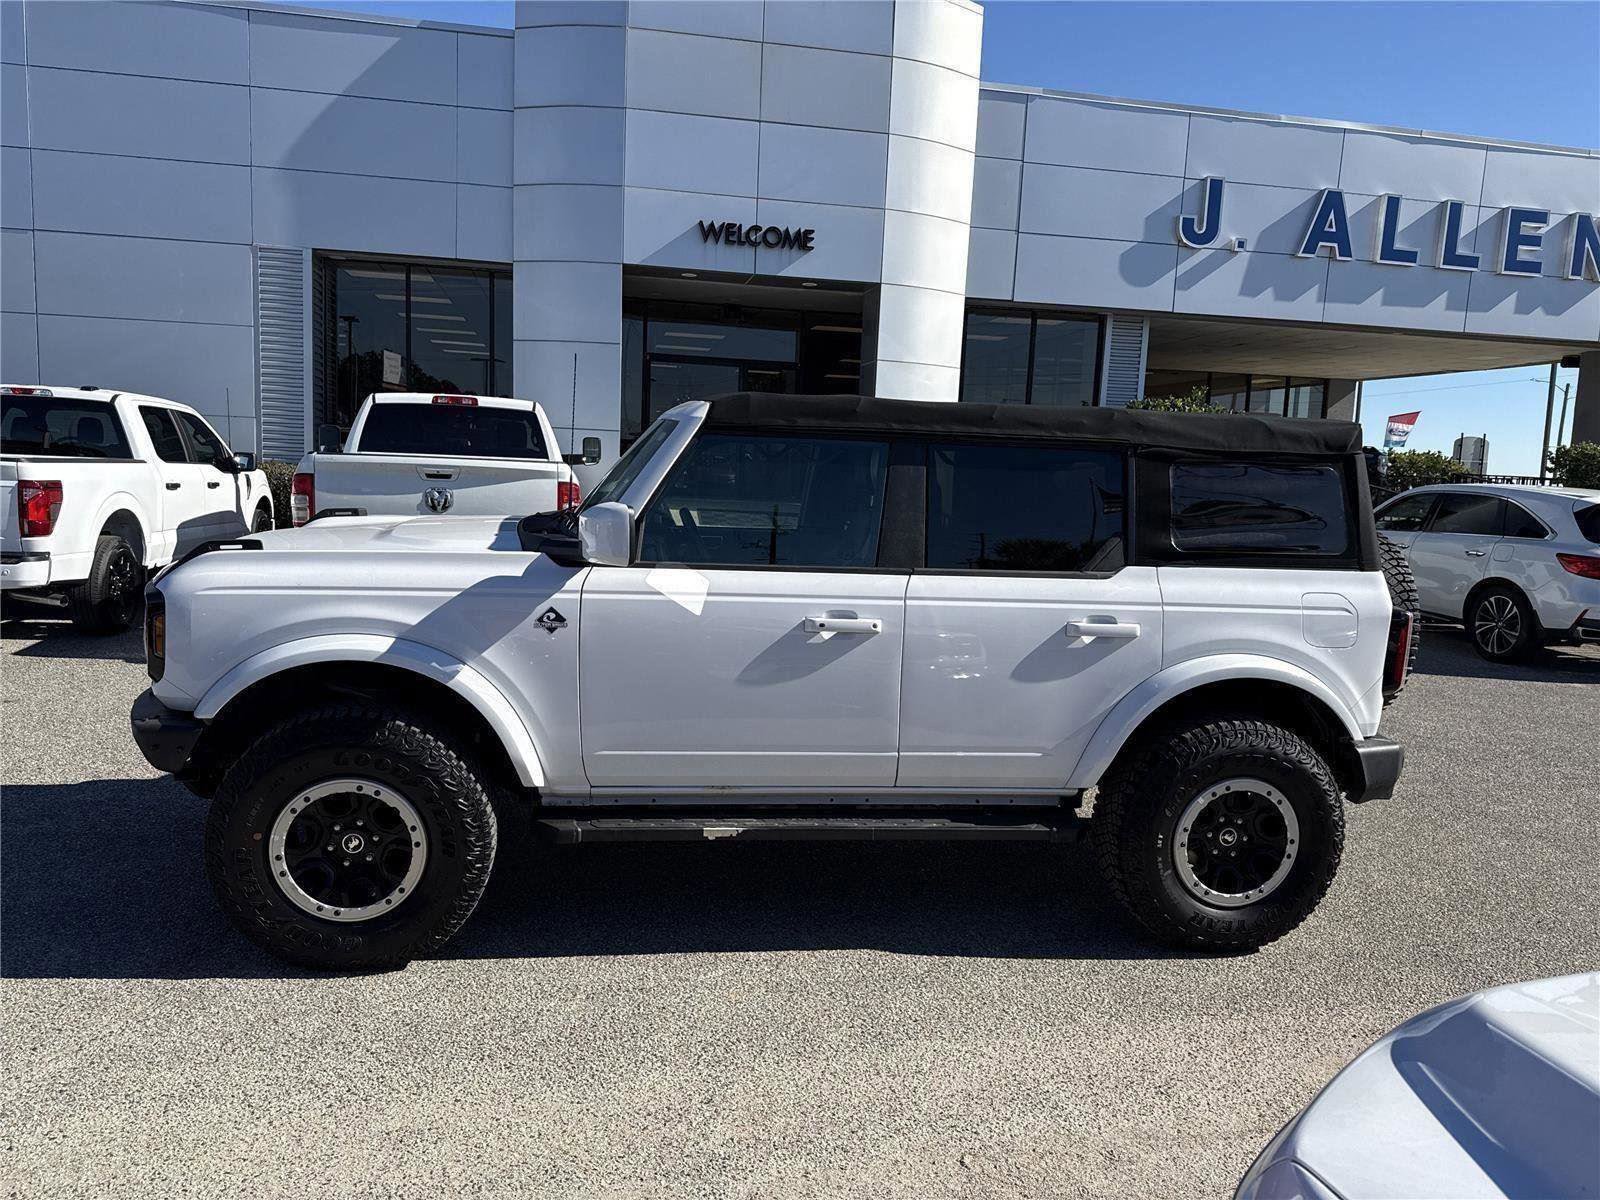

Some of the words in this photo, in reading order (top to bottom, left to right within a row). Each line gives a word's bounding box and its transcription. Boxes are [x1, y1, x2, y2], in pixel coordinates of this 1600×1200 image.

[699, 219, 815, 251] WELCOME
[1176, 175, 1248, 253] J.
[1296, 187, 1600, 281] ALLEN
